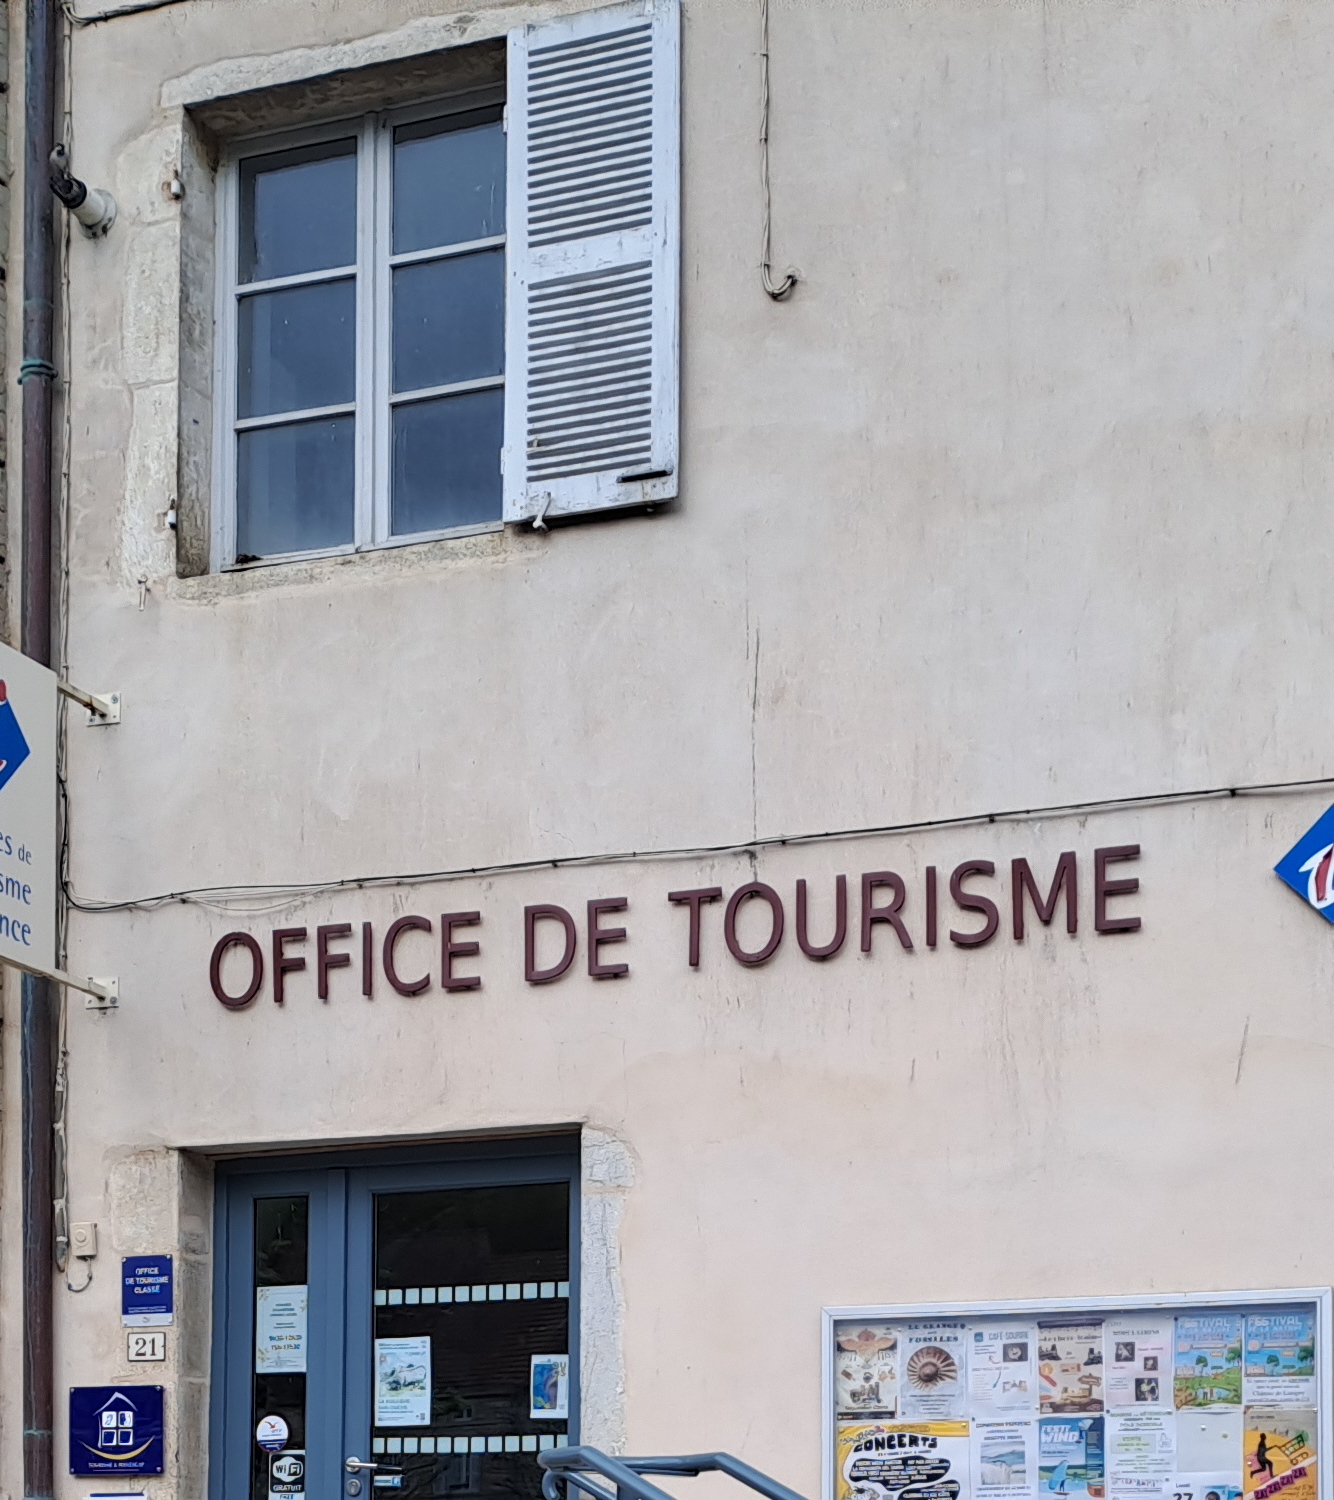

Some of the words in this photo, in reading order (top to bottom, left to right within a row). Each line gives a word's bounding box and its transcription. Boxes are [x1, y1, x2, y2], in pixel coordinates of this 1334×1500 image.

[18, 843, 32, 866] de
[209, 910, 482, 1012] OFFICE
[524, 897, 630, 988] DE
[667, 844, 1142, 972] TOURISME
[125, 1277, 135, 1285] DE
[136, 1275, 169, 1284] TOURISME
[135, 1266, 160, 1275] OFFICE
[134, 1337, 157, 1357] 21
[853, 1433, 938, 1453] CONCERTS
